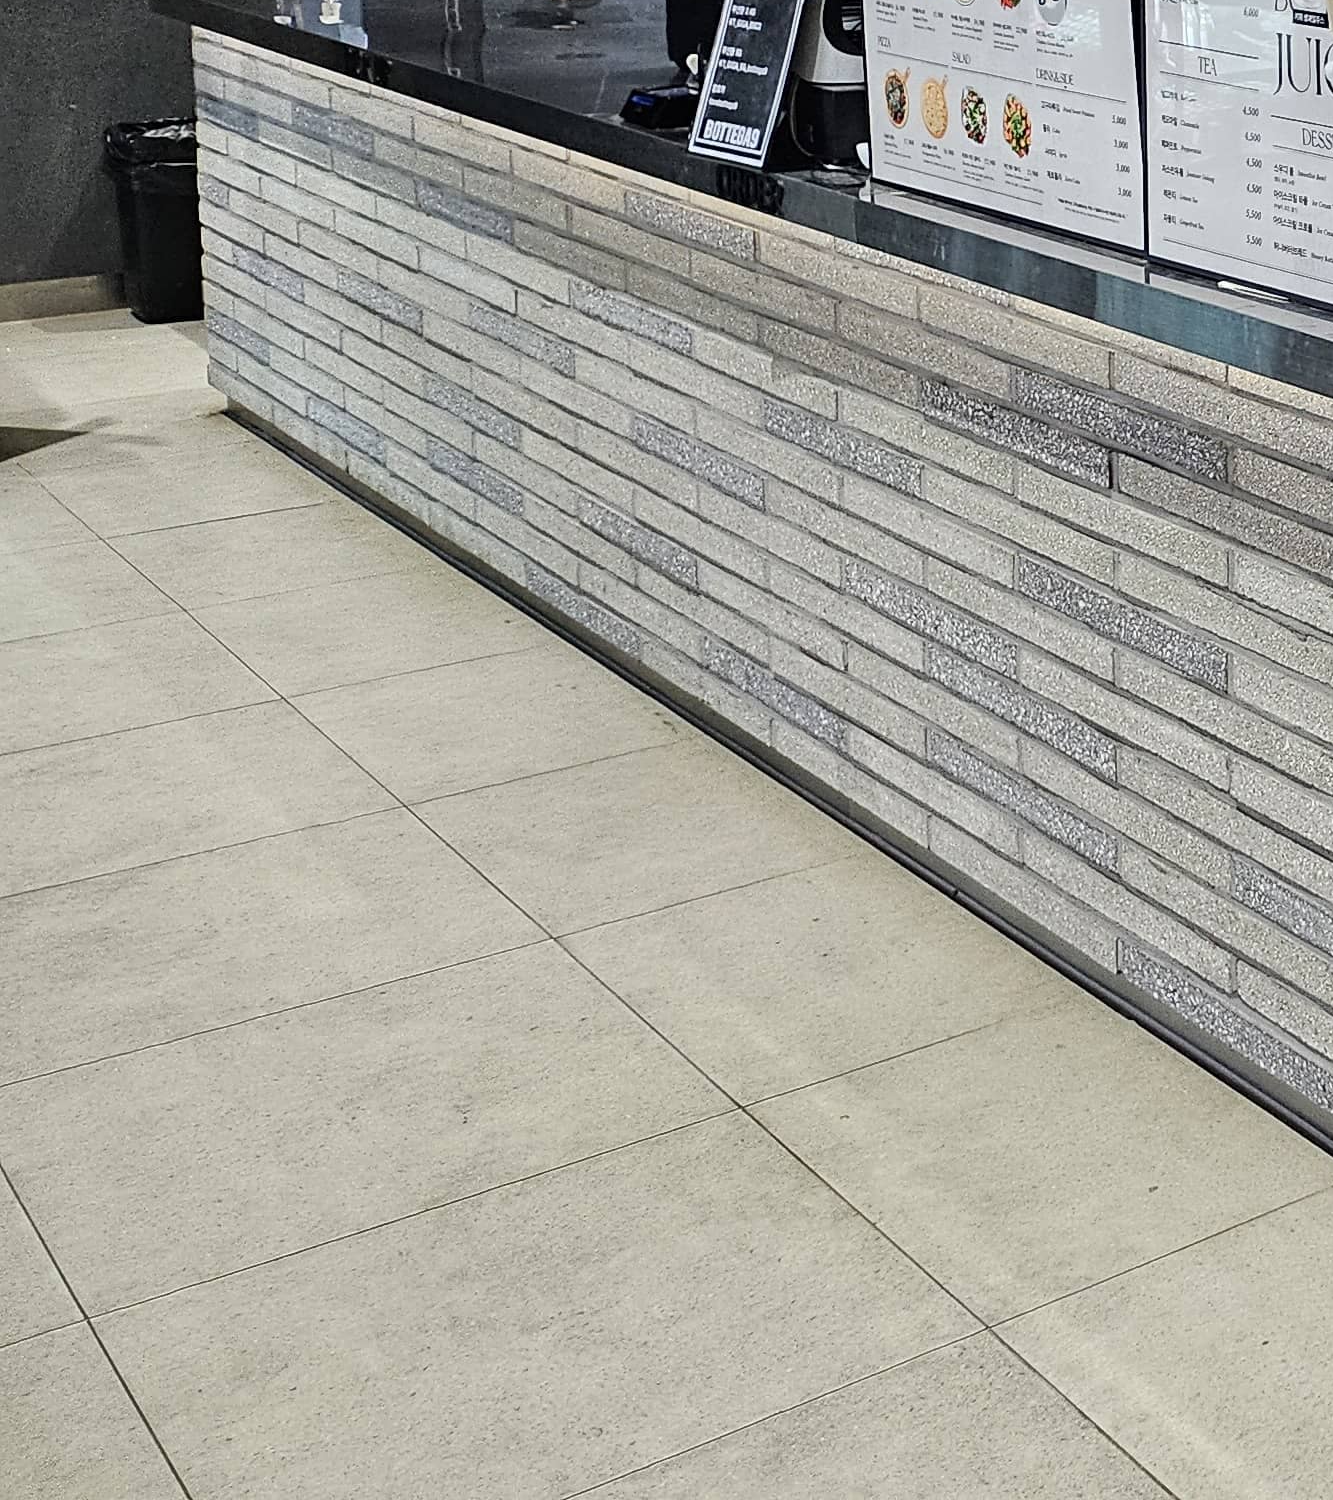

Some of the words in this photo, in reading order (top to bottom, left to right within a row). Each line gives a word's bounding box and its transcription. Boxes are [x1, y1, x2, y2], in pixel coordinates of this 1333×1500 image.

[1197, 55, 1218, 77] TEA
[1242, 105, 1260, 117] 4,500
[1244, 131, 1262, 143] 4,500
[1246, 157, 1263, 169] 4,500
[1246, 183, 1263, 195] 4,500
[1245, 208, 1262, 221] 5,500
[1245, 234, 1263, 248] 5,500
